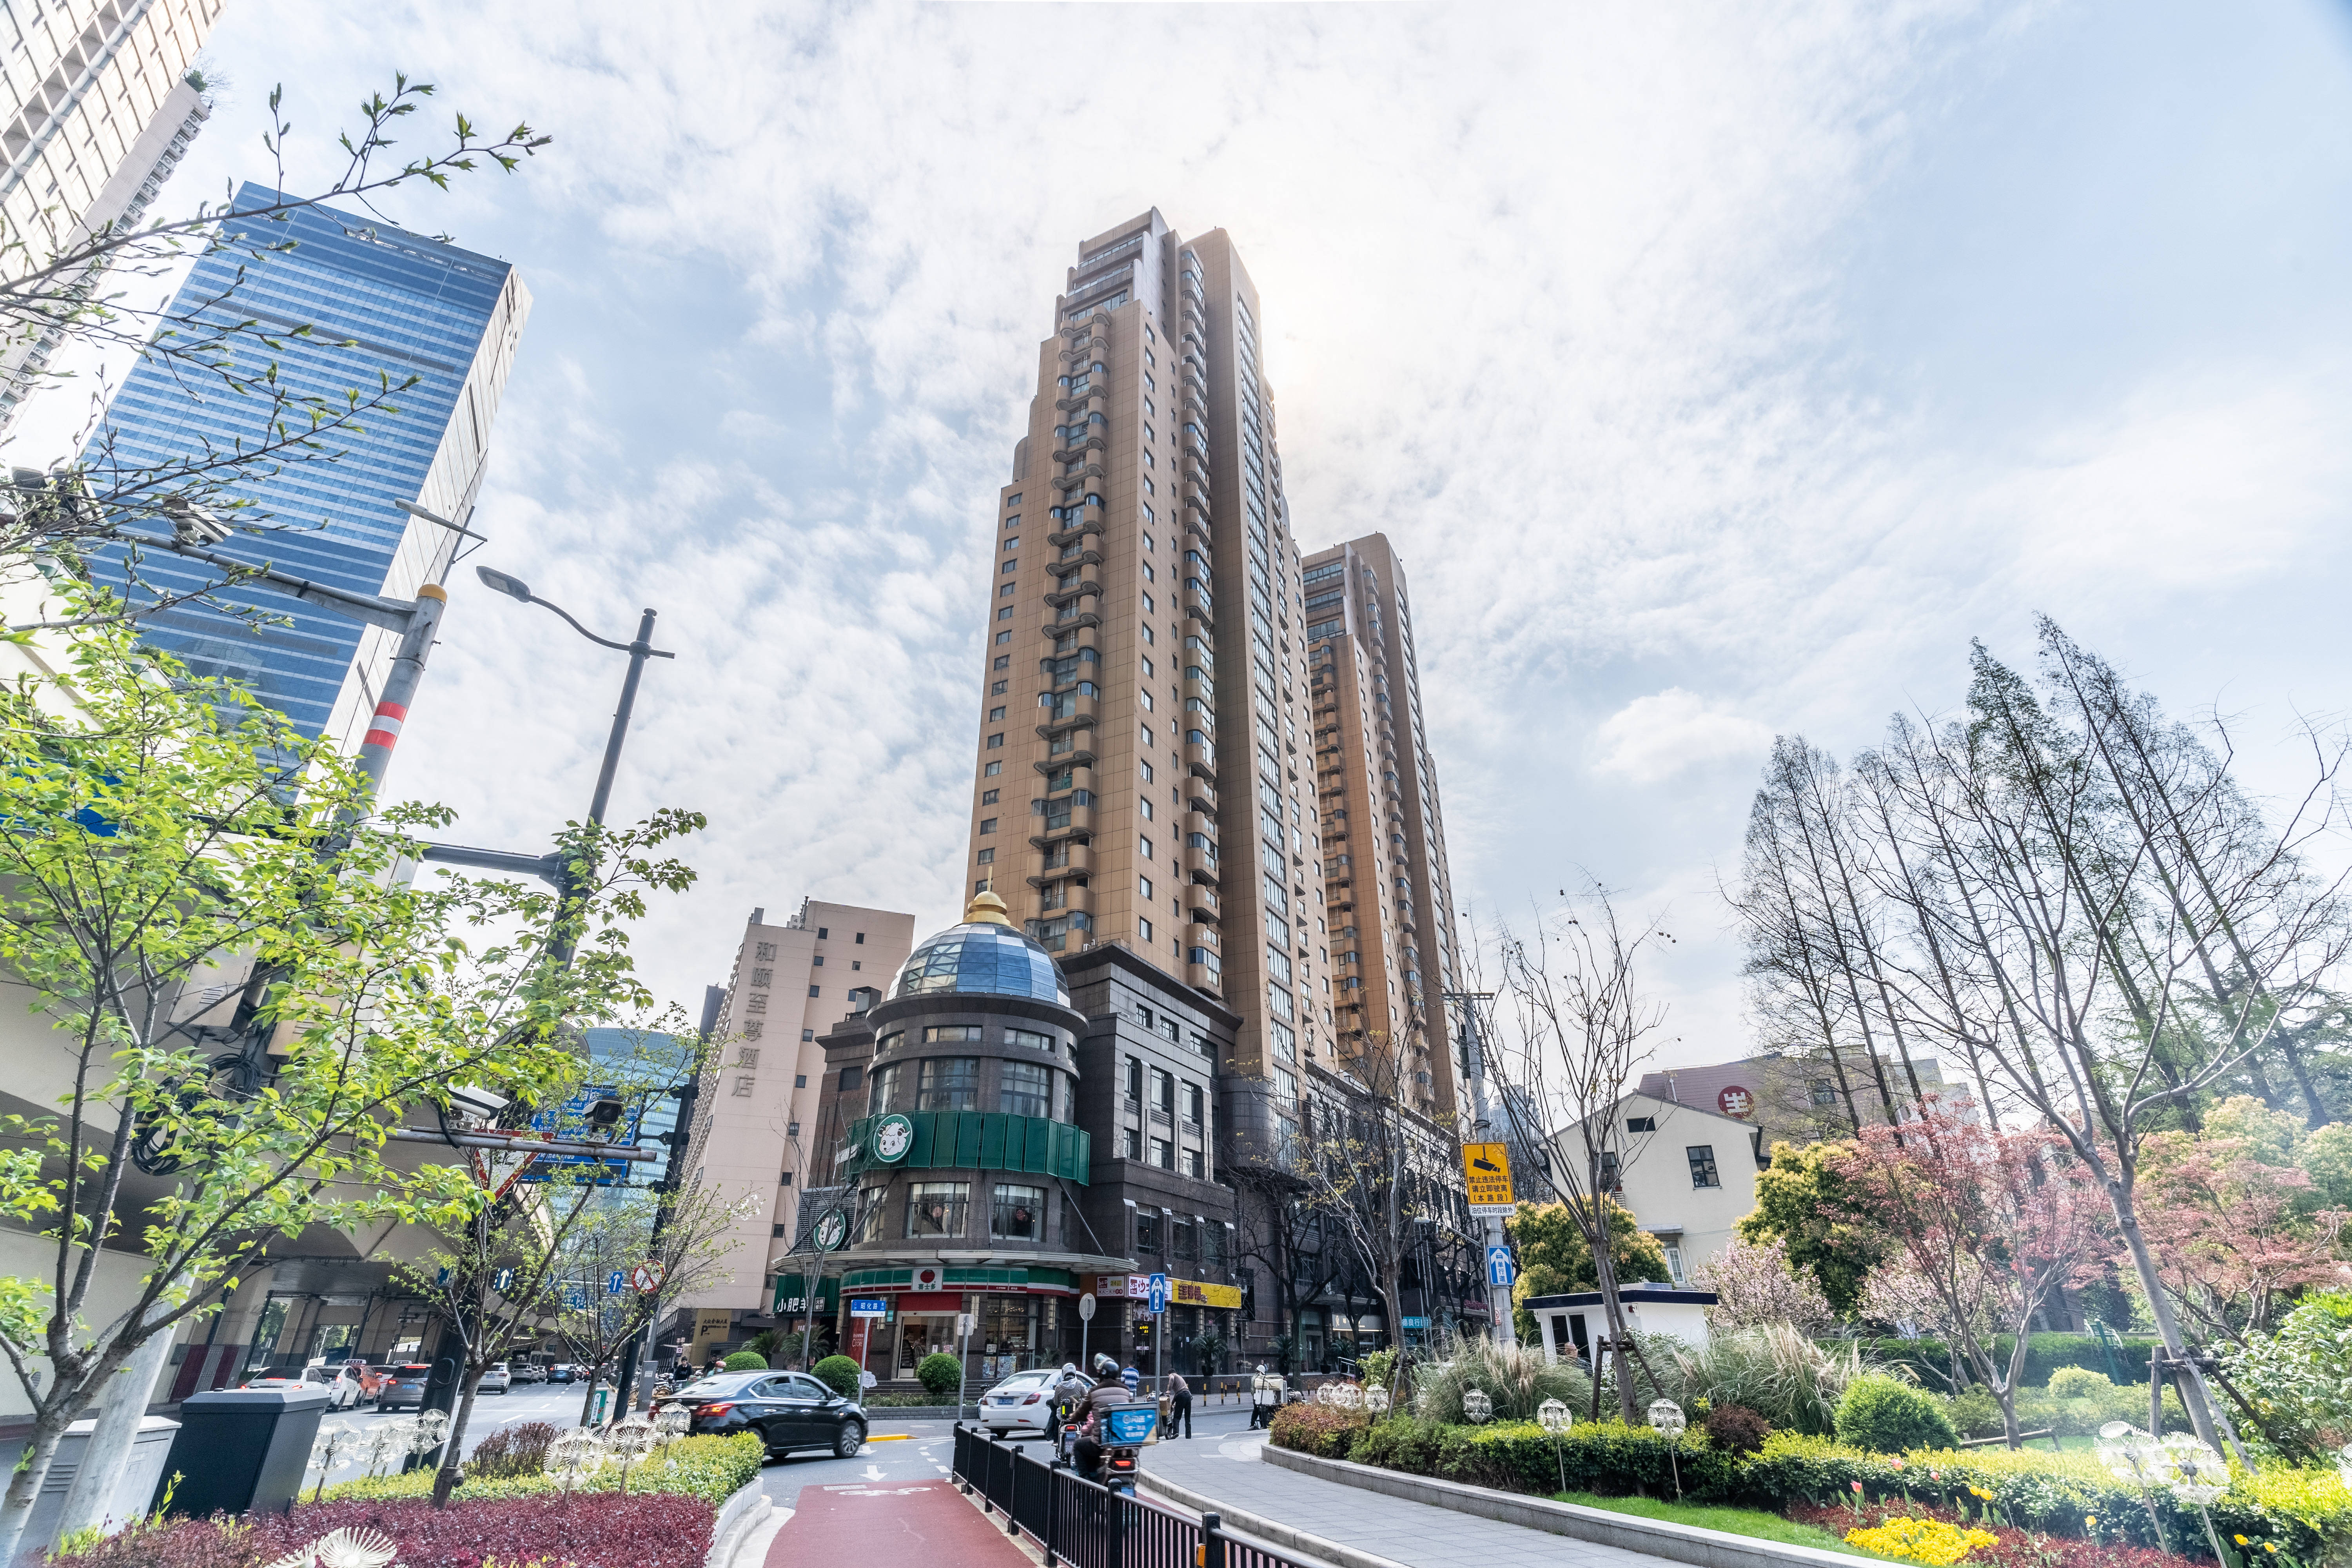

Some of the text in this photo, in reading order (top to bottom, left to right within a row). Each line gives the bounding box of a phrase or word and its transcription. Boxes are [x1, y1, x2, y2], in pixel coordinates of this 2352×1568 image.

[731, 941, 777, 1097] 和颐至尊酒店
[1469, 1175, 1508, 1183] 禁止违法停车
